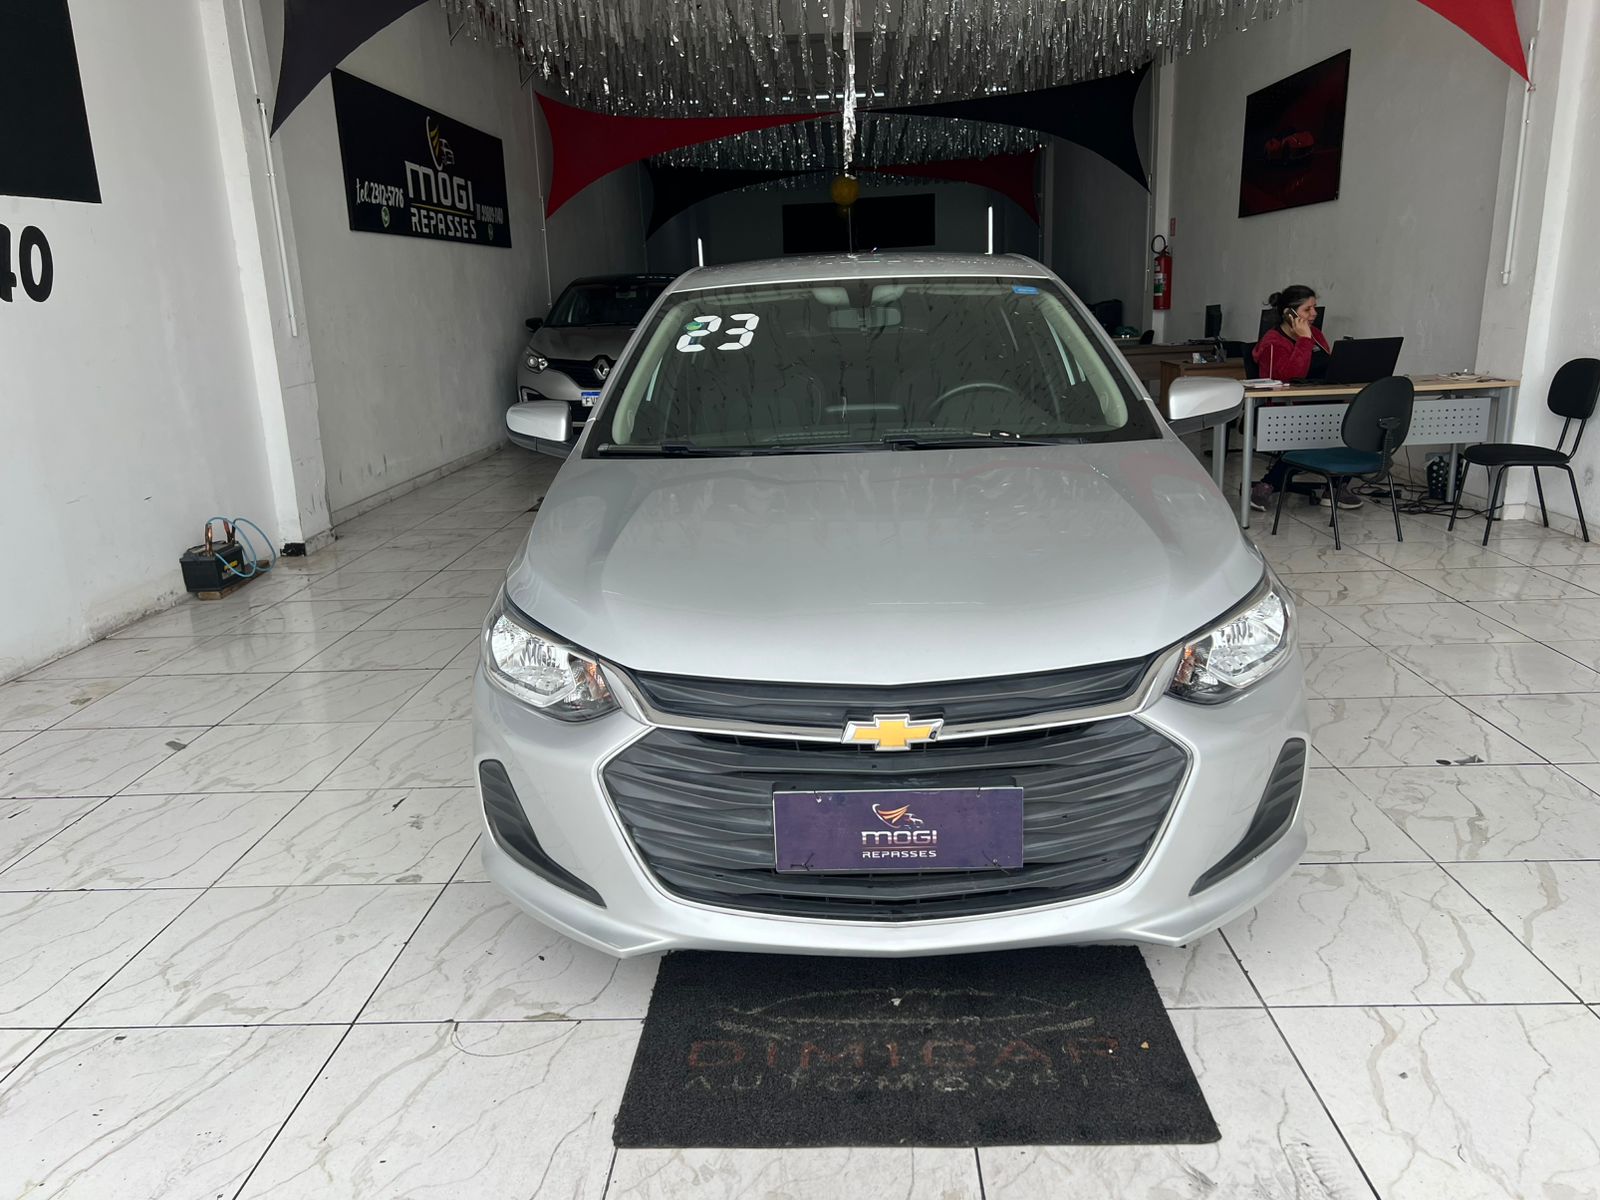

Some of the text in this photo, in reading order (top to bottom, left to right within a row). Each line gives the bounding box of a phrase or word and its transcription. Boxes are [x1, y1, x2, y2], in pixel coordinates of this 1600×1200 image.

[405, 160, 474, 211] MOGI
[410, 207, 477, 239] REPASSES
[676, 313, 760, 353] 23
[861, 830, 937, 845] MOGI
[862, 850, 937, 859] REPASSES
